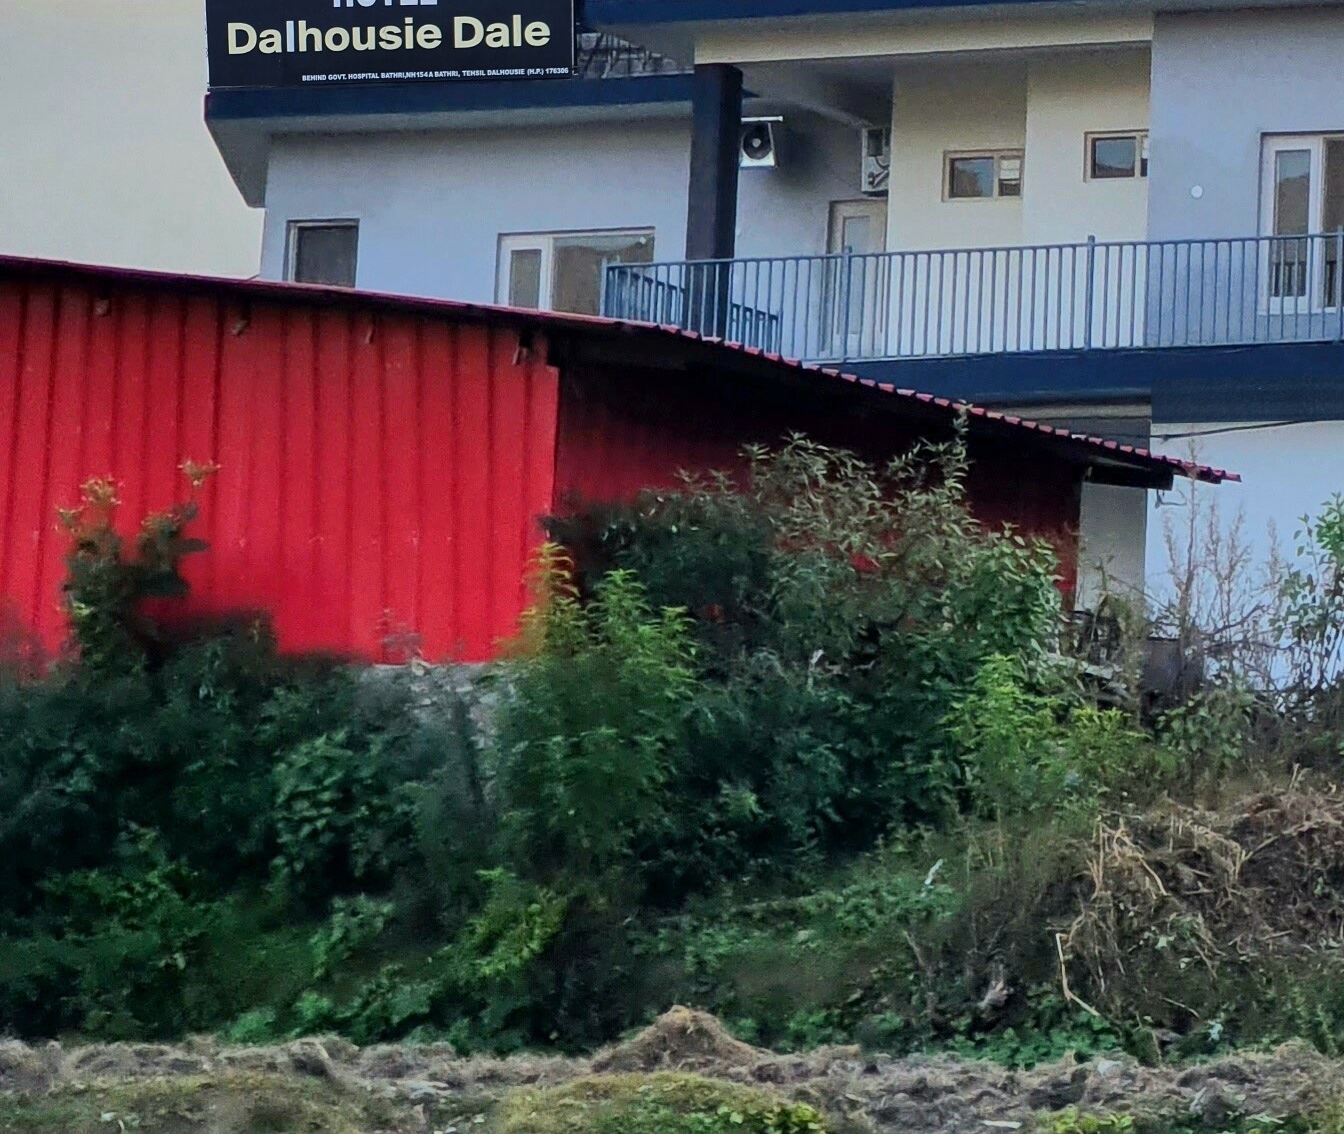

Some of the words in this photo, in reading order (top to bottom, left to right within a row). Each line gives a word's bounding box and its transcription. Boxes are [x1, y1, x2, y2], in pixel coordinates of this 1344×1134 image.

[227, 16, 443, 55] Dalhousie
[453, 14, 551, 49] Dale
[301, 74, 327, 82] BEHIND
[327, 73, 347, 81] GOVT.
[348, 72, 380, 81] HOSPITAL
[461, 69, 486, 77] TEHSIL
[487, 68, 526, 77] DALHOUSIE
